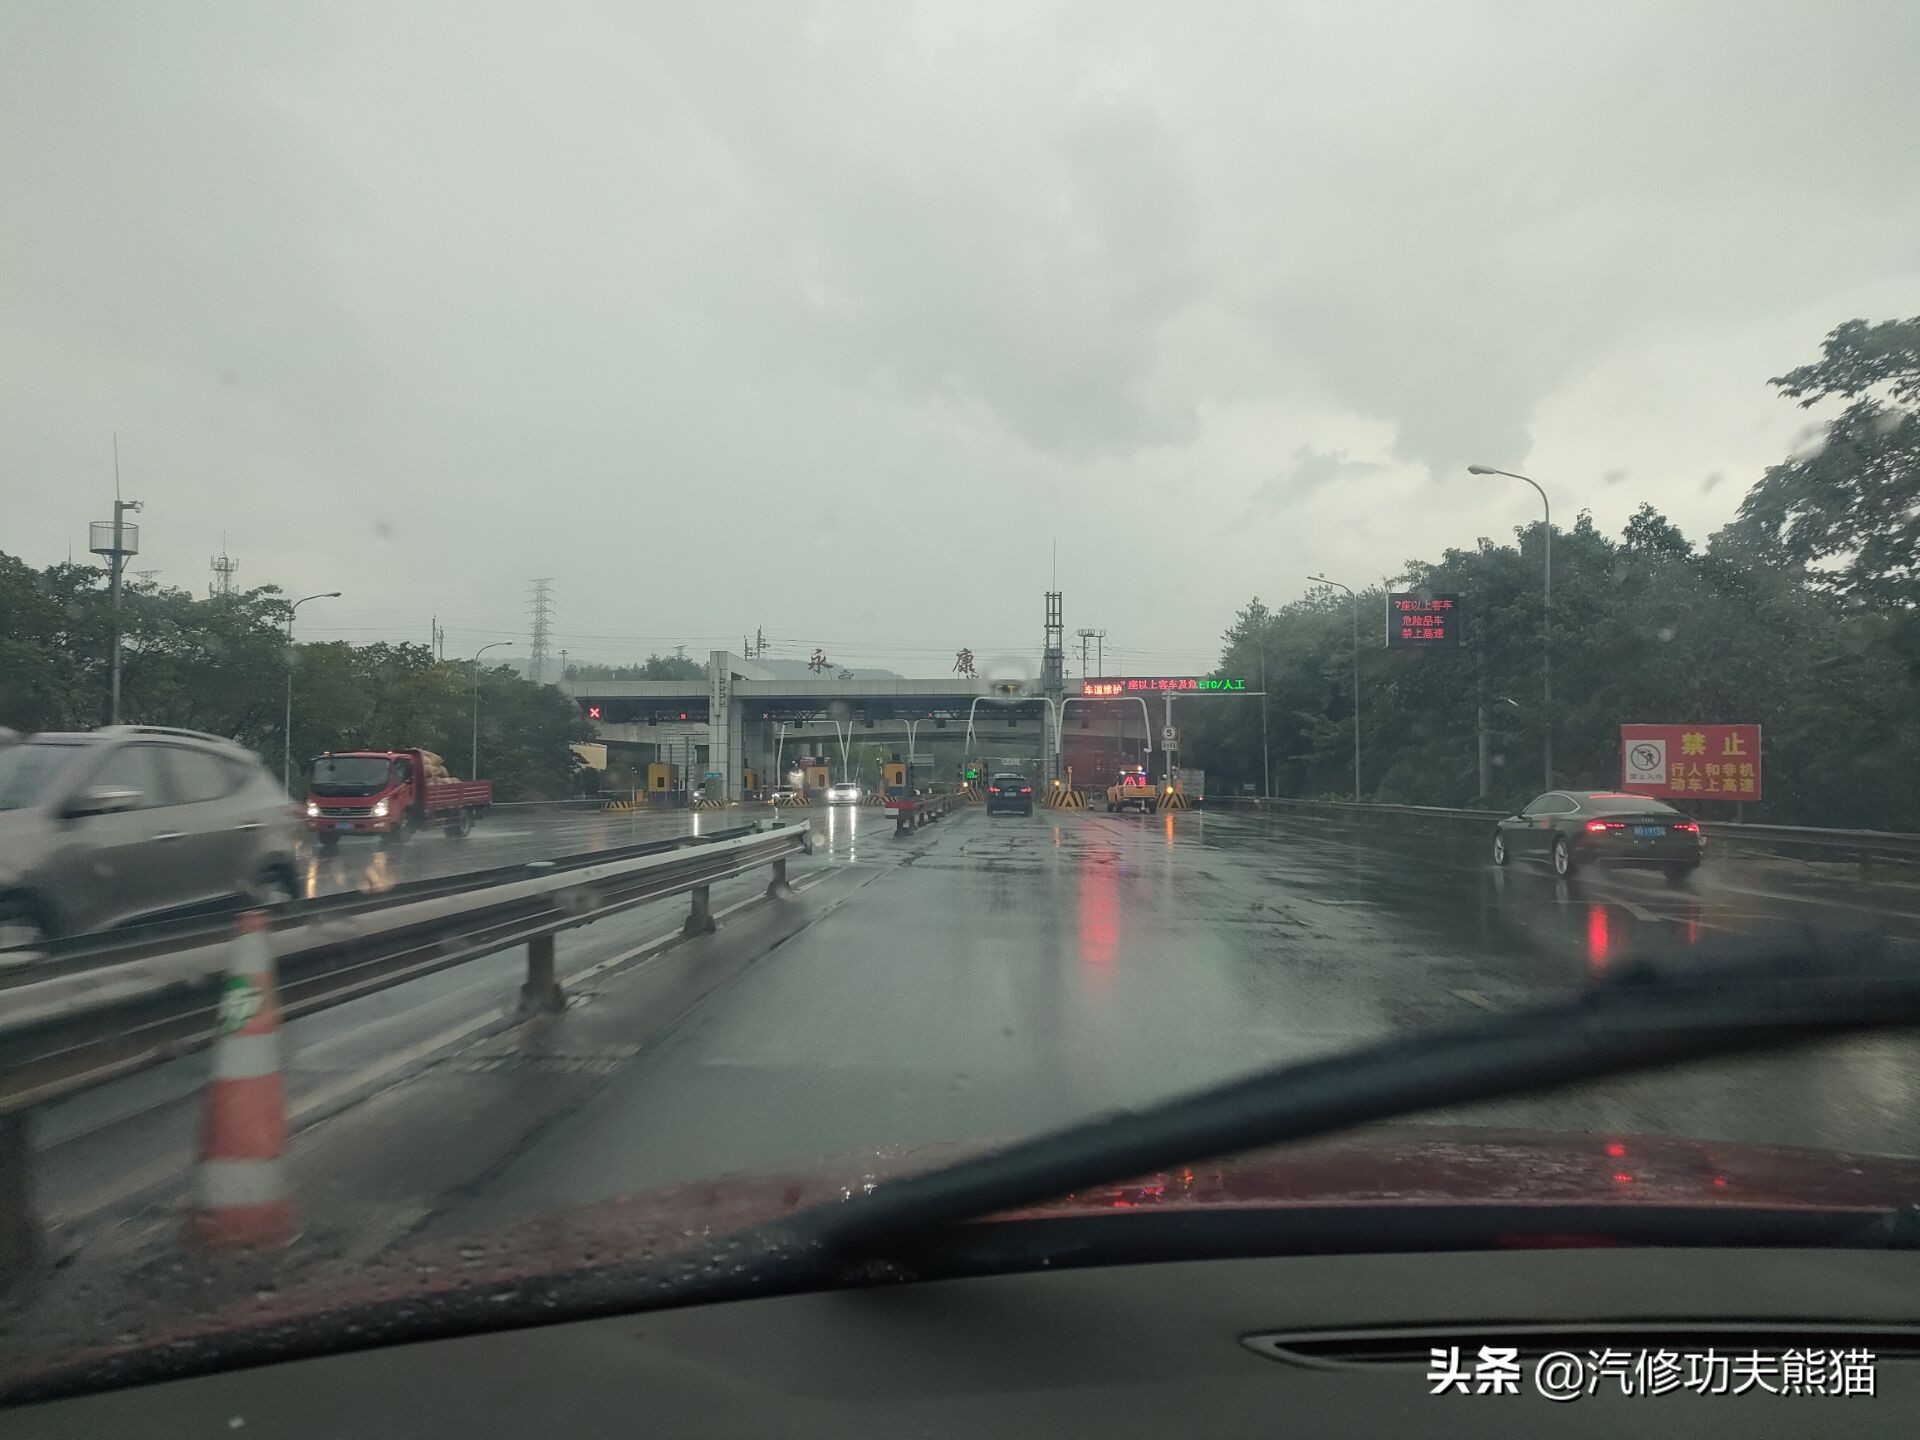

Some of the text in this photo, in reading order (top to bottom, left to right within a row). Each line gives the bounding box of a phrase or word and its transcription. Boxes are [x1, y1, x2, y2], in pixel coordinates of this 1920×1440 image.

[1395, 599, 1453, 611] 7座以上客车
[1401, 615, 1444, 626] 危险品车
[1401, 628, 1444, 639] 禁上高速
[808, 647, 976, 674] 永 康
[1083, 685, 1122, 695] 车道维护
[1198, 679, 1246, 690] ETC/人工
[1681, 732, 1747, 756] 禁止
[1670, 762, 1755, 777] 行人和非机
[1670, 778, 1755, 792] 动车上高速
